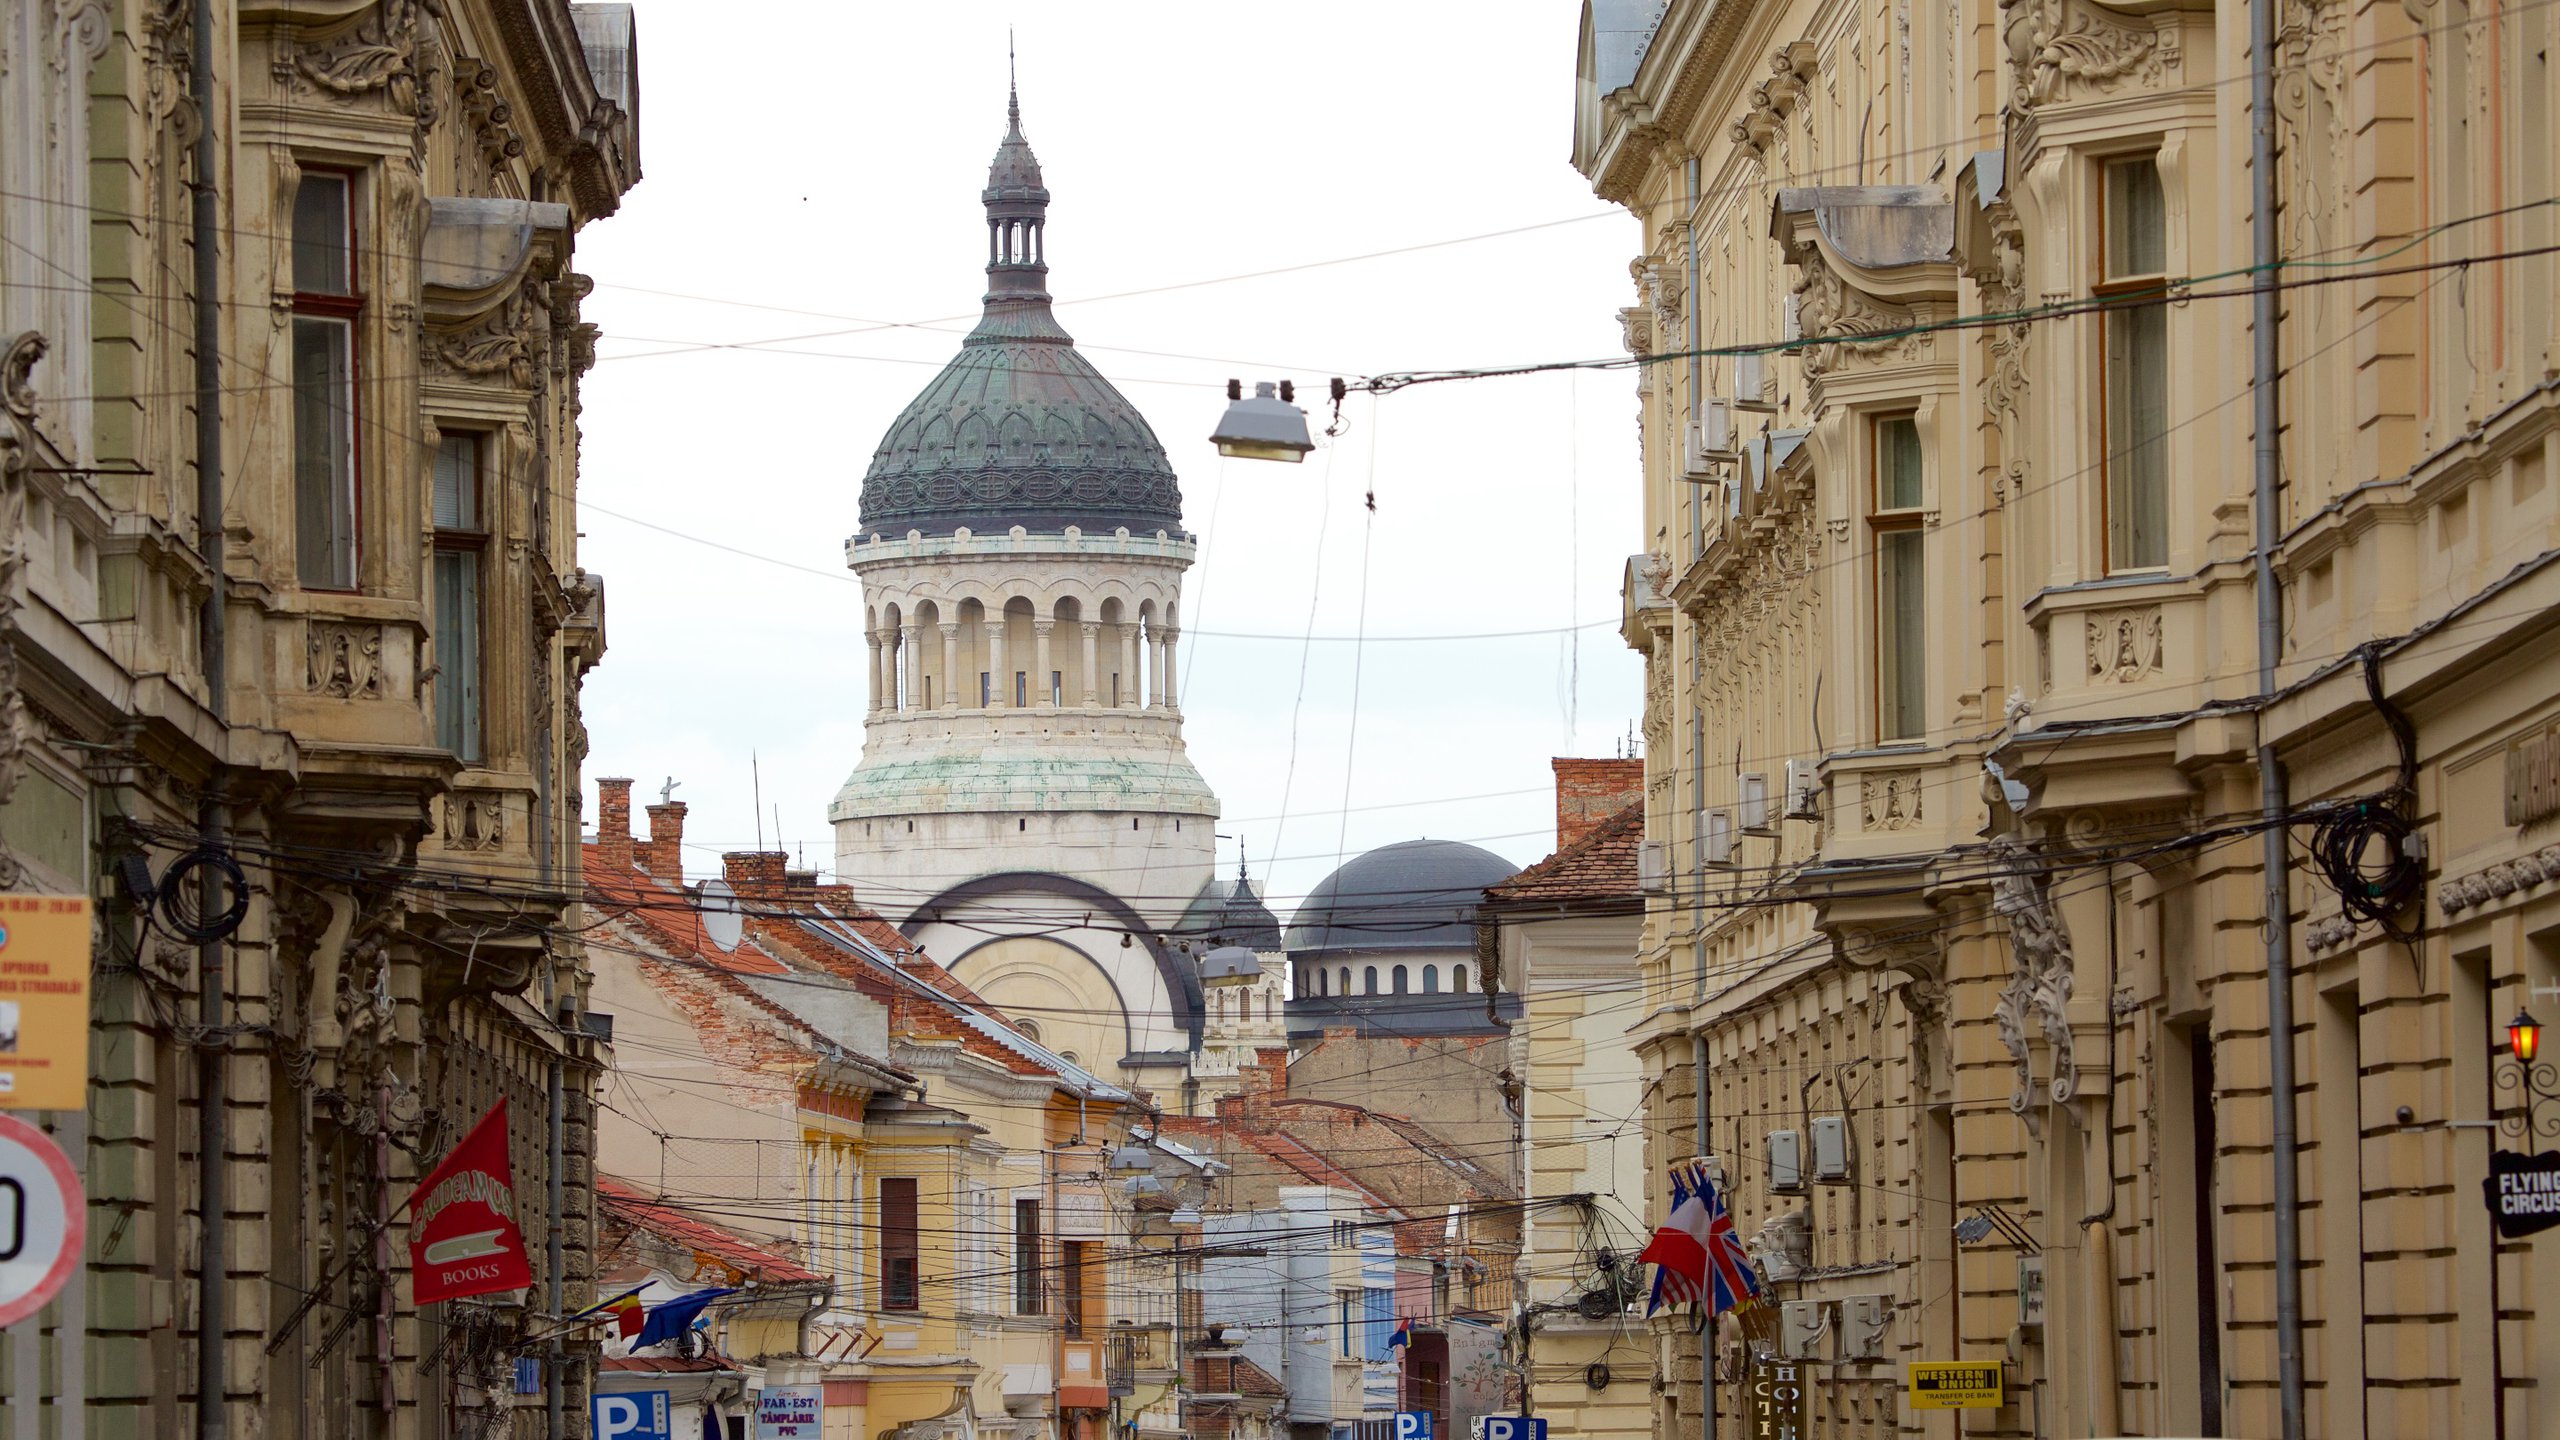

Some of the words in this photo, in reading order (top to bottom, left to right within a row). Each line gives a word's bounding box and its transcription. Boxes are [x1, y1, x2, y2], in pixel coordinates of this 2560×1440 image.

[2499, 1170, 2560, 1194] FLYING
[411, 1169, 517, 1243] GAUDEAMUS
[442, 1263, 500, 1285] BOOKS
[1453, 1330, 1496, 1348] Enigm
[1917, 1370, 1984, 1380] WESTERN
[1938, 1380, 1985, 1389] UNION
[763, 1398, 786, 1409] FAR
[793, 1398, 815, 1409] EST
[597, 1397, 640, 1440] P
[1396, 1413, 1418, 1440] P
[778, 1426, 798, 1437] PVC
[1489, 1420, 1514, 1440] P
